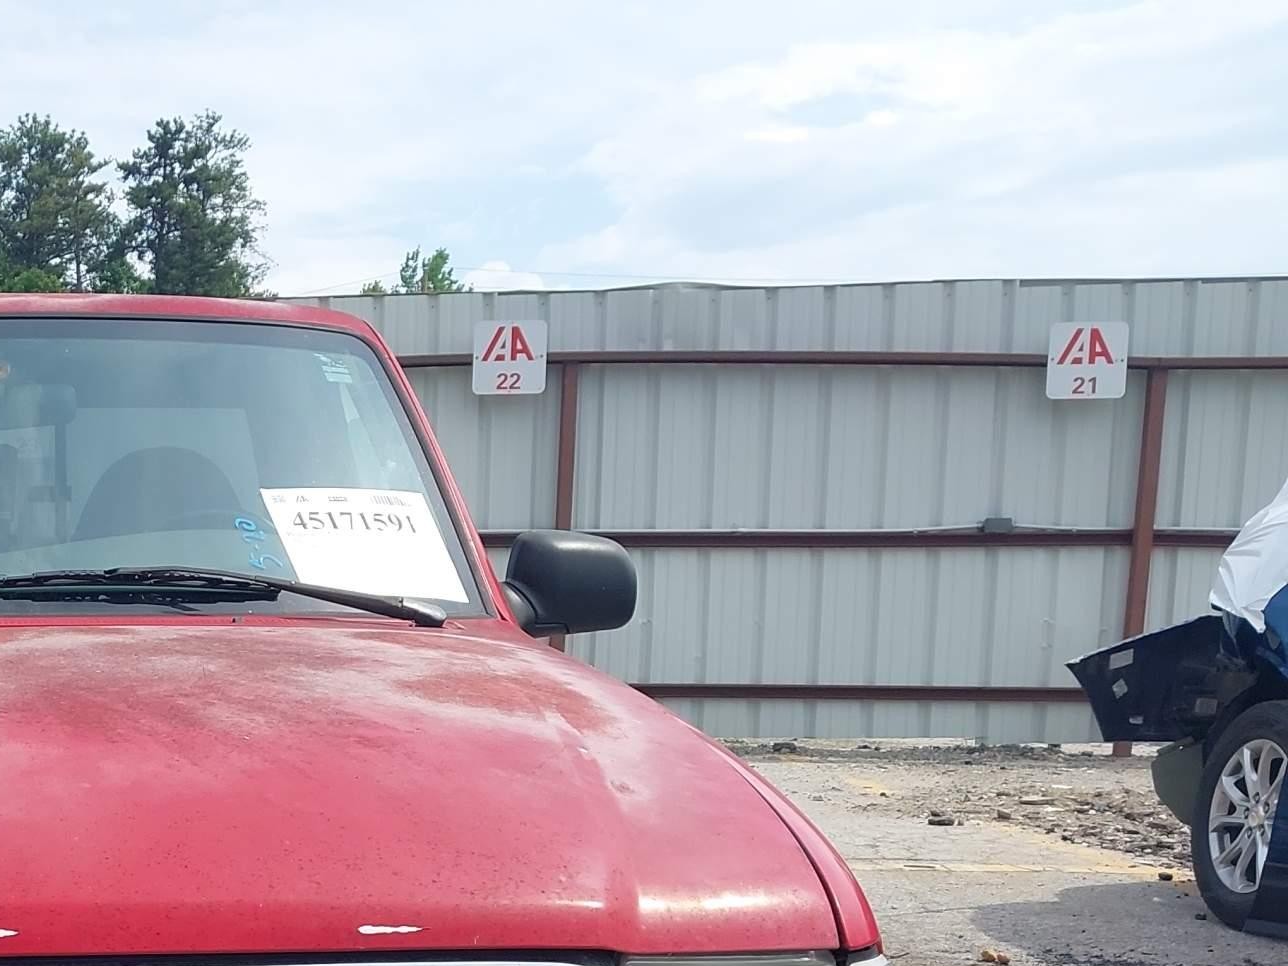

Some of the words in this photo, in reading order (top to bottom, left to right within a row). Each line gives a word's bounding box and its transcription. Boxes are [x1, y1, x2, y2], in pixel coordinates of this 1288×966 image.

[496, 373, 521, 390] 22
[1071, 377, 1097, 394] 21
[292, 511, 417, 534] 45171591
